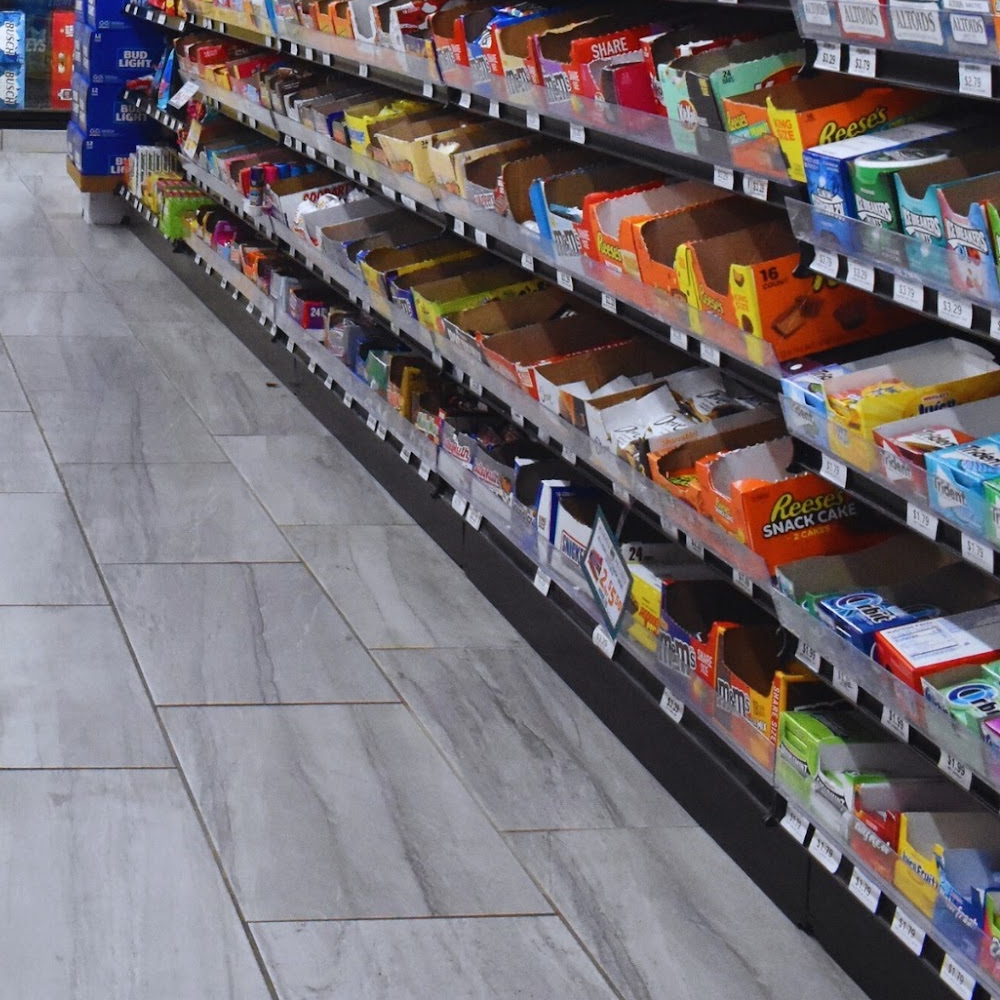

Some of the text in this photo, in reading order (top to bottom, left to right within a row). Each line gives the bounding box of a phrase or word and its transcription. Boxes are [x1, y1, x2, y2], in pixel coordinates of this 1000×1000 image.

[803, 2, 829, 17] ALTOIDS
[844, 5, 879, 26] ALTOIDS
[895, 10, 936, 32] ALTOIDS
[952, 17, 985, 33] ALTOIDS
[5, 21, 15, 55] BUSCH
[591, 37, 628, 59] SHARE
[119, 59, 152, 68] LIGHT
[124, 50, 148, 59] BUD
[722, 69, 732, 78] 24
[964, 75, 981, 88] $2.79
[5, 71, 15, 104] BUSCH
[116, 113, 148, 122] LIGHT
[773, 118, 793, 131] KING
[819, 107, 888, 145] Reese's
[776, 129, 796, 141] SIZE
[760, 267, 779, 282] 16
[943, 300, 962, 315] $3.29
[934, 476, 966, 504] Trident
[771, 492, 844, 522] Reese's
[912, 508, 930, 526] $1.79
[762, 503, 857, 538] SNACK CAKE
[801, 525, 830, 537] CAKES
[629, 546, 643, 562] 24
[836, 592, 895, 623] Orbit
[717, 677, 751, 719] m&m's
[770, 687, 780, 743] SHARE SIZE
[948, 755, 966, 776] $1.99
[899, 918, 916, 939] $1.79
[948, 964, 965, 985] $1.79
